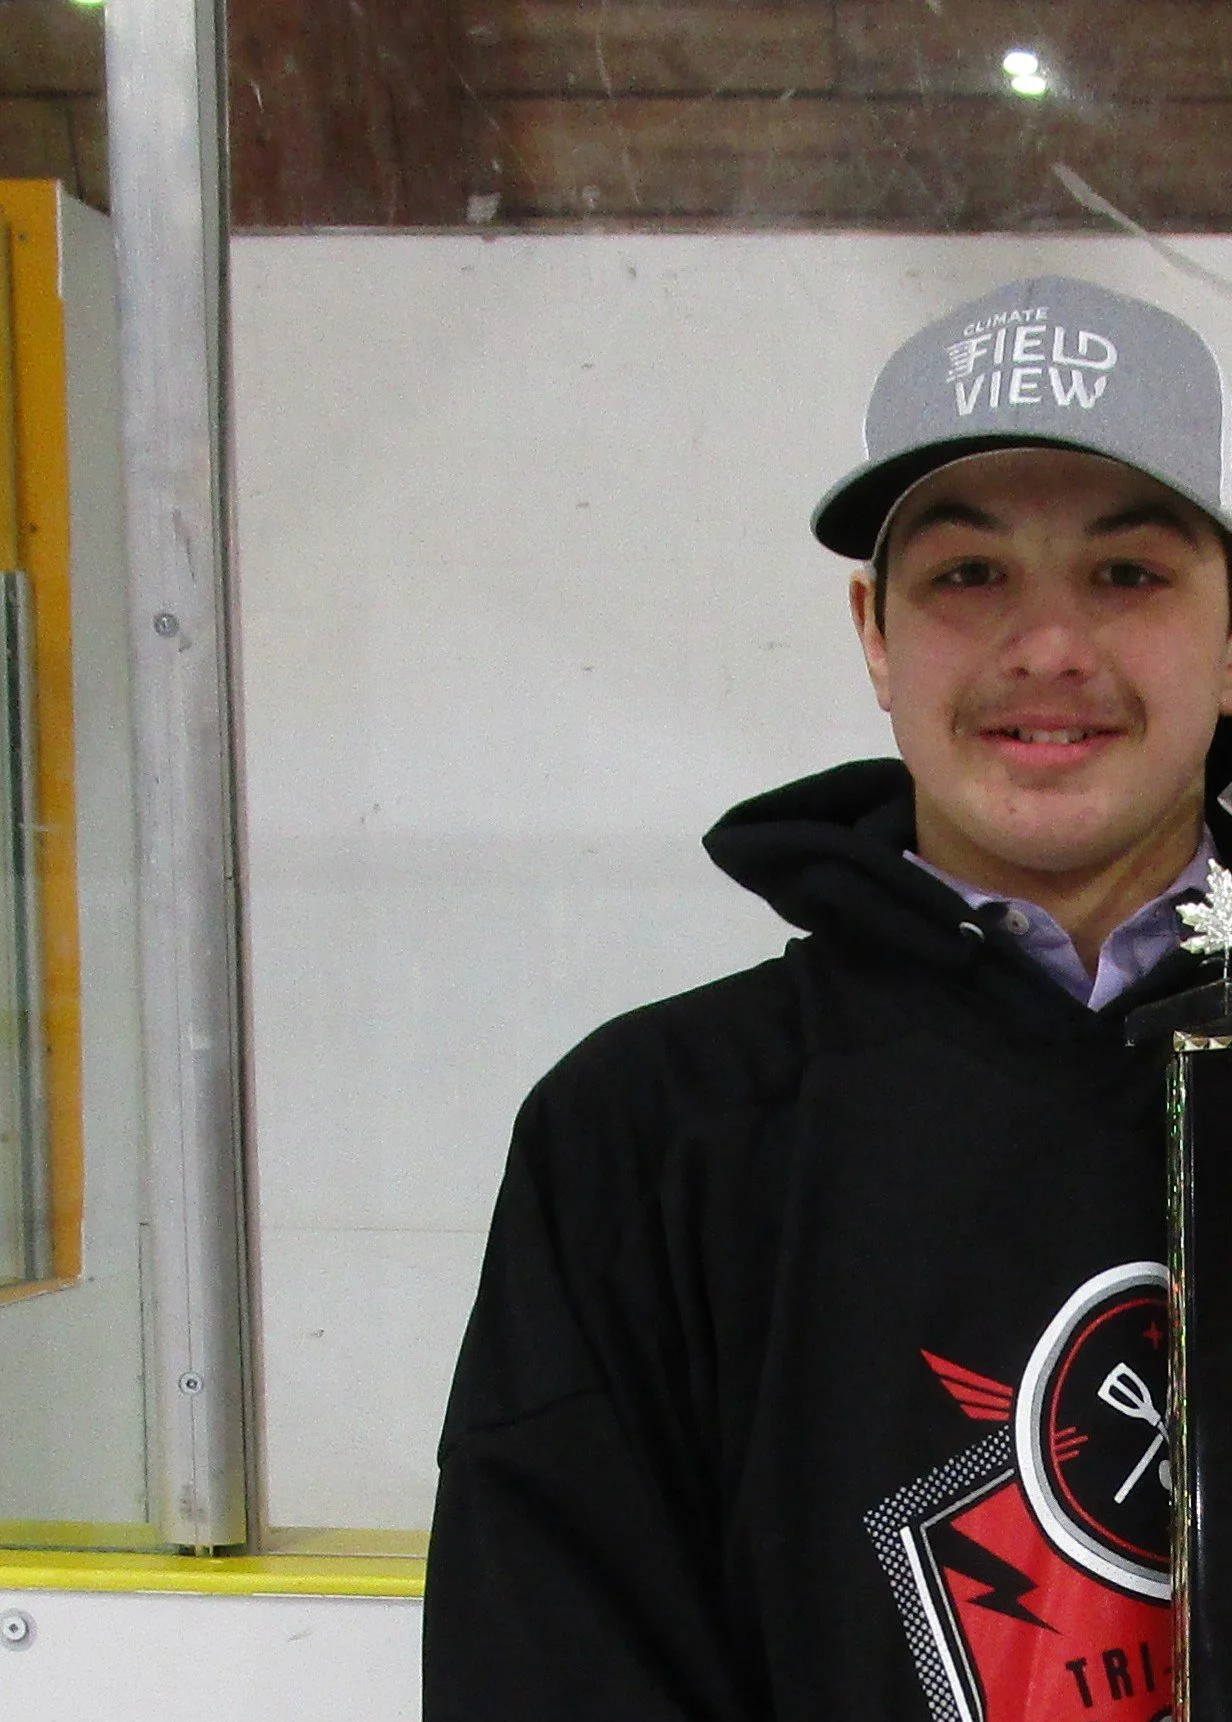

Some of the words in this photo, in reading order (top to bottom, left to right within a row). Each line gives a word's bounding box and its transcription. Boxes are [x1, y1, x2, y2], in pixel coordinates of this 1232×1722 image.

[963, 307, 1049, 337] CLIMATE
[948, 324, 1118, 377] FIELD
[955, 366, 1107, 416] VIEW
